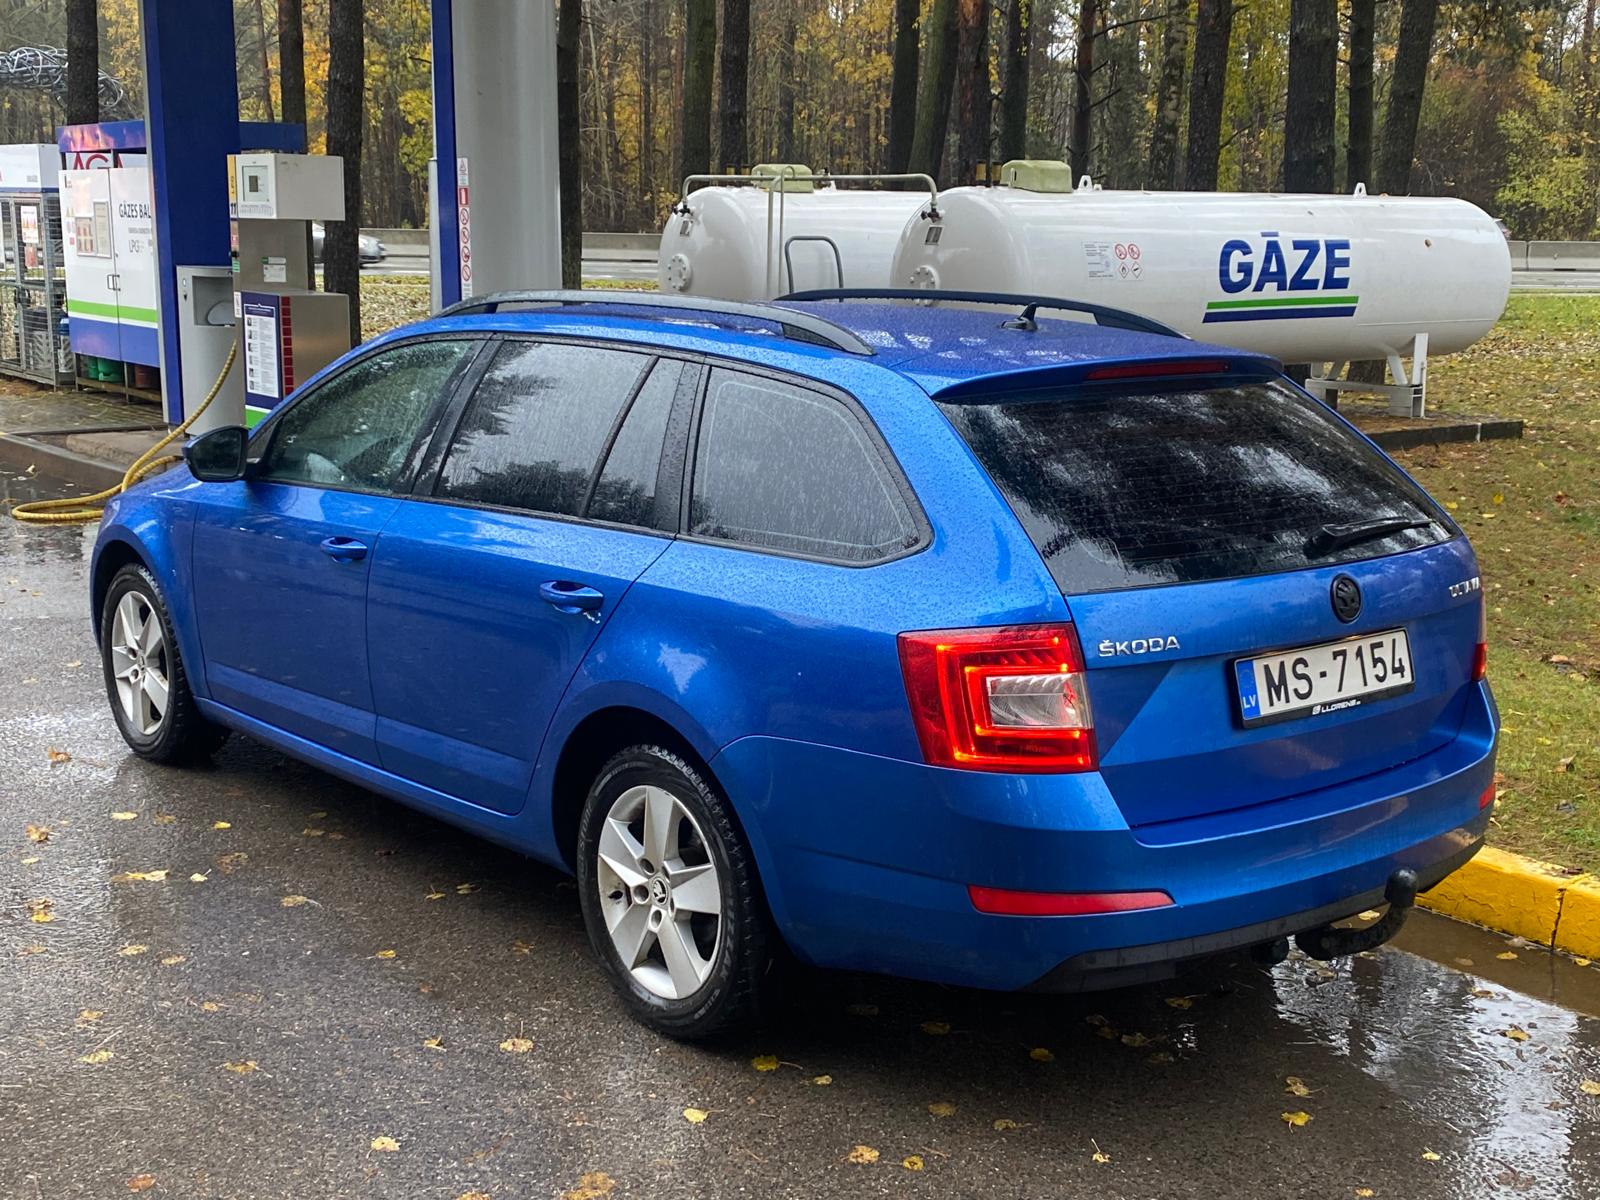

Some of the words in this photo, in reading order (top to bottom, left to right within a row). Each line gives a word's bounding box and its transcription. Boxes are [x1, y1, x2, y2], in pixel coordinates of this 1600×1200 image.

[1218, 231, 1351, 294] GĀZE
[1099, 636, 1180, 657] ŠKODA
[1263, 638, 1405, 707] MS-7154
[1243, 694, 1257, 709] LV
